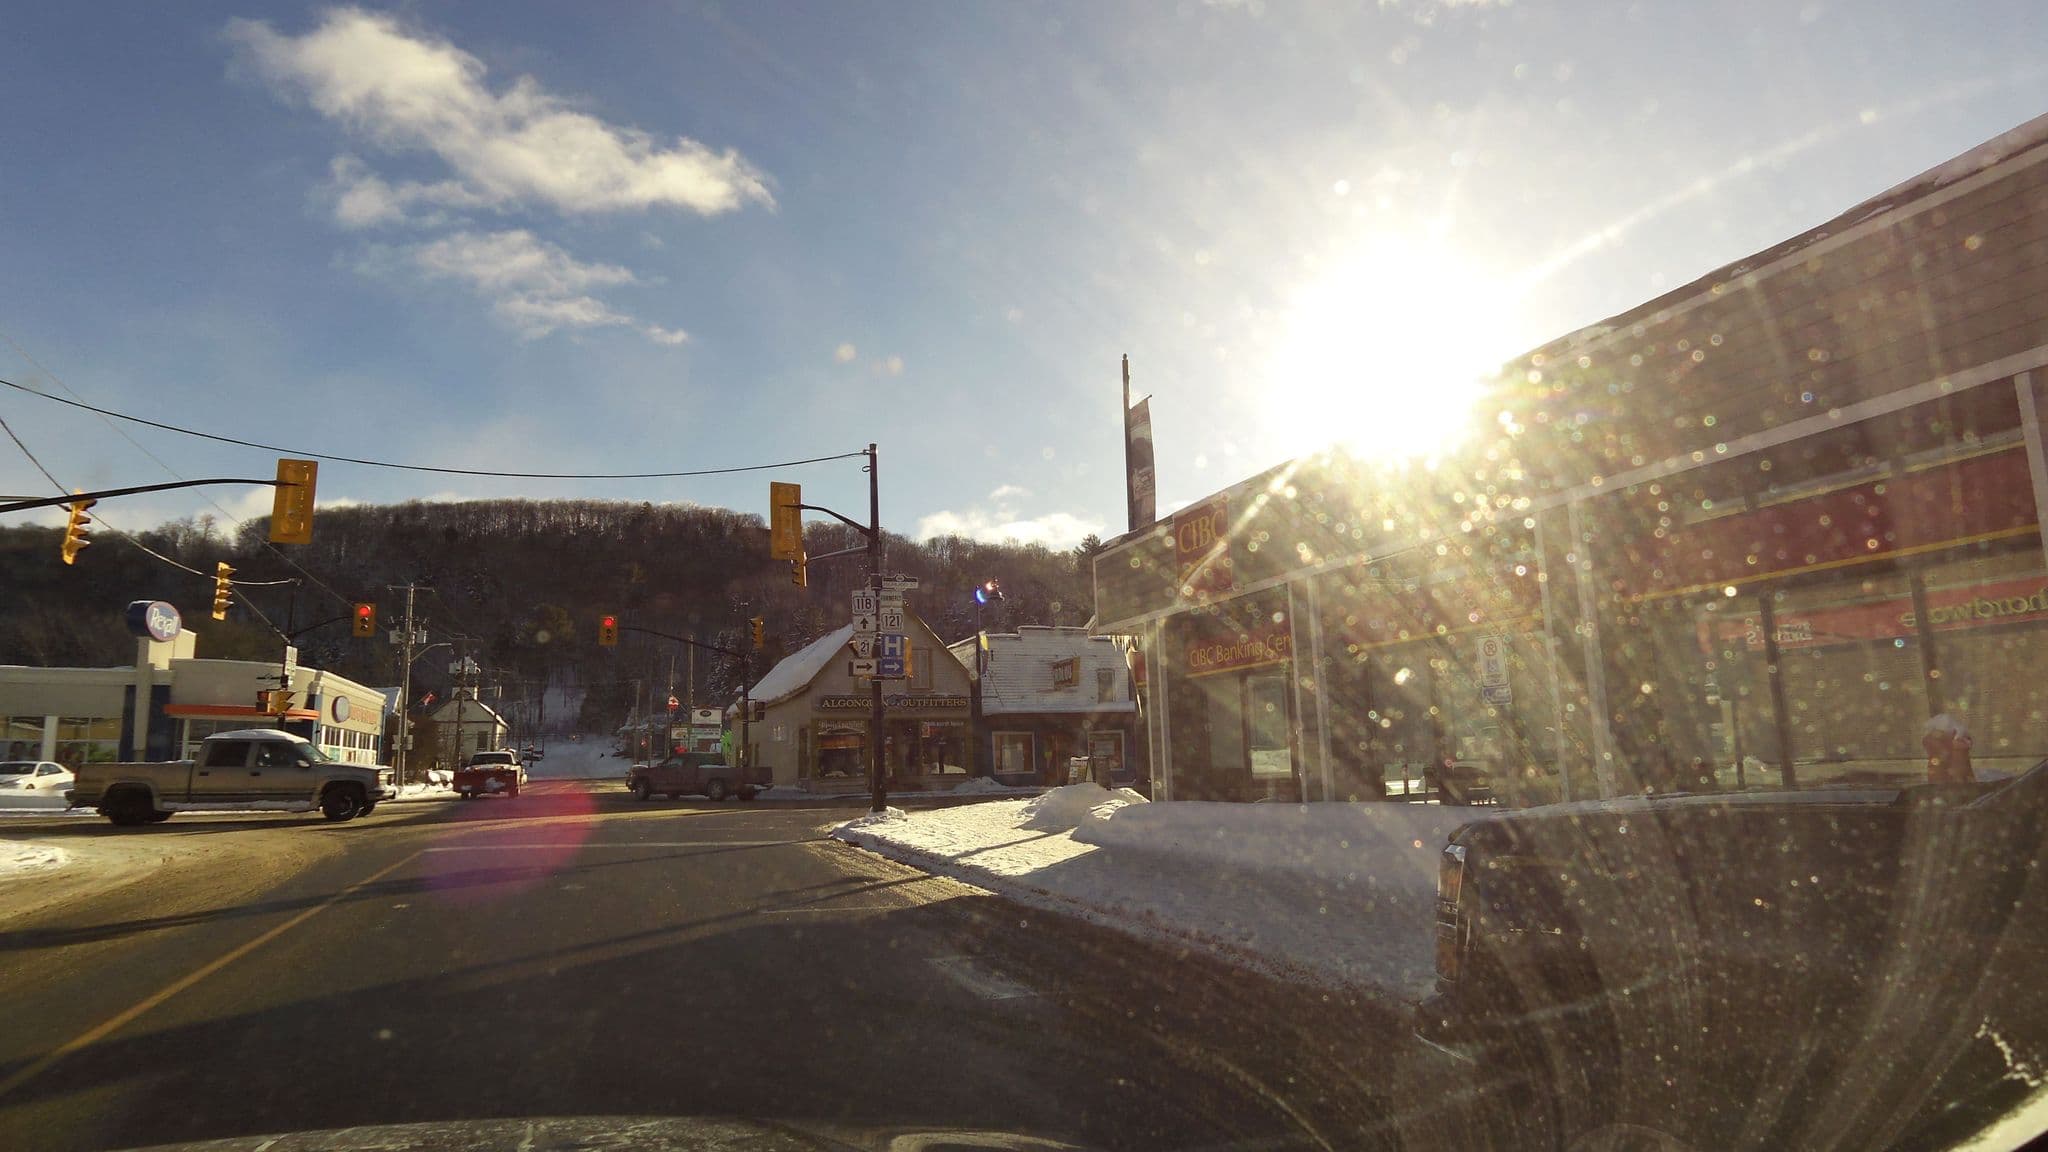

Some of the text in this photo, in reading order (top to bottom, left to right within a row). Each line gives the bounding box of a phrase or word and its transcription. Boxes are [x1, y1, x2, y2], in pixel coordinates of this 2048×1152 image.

[1179, 510, 1225, 552] CIBC
[857, 598, 872, 610] 118
[885, 616, 900, 627] 121
[860, 641, 870, 653] 21
[885, 636, 900, 656] H
[1191, 646, 1214, 667] CIBC
[1216, 639, 1263, 663] Banking
[822, 698, 967, 708] ALGONQUN OUTFITTERS
